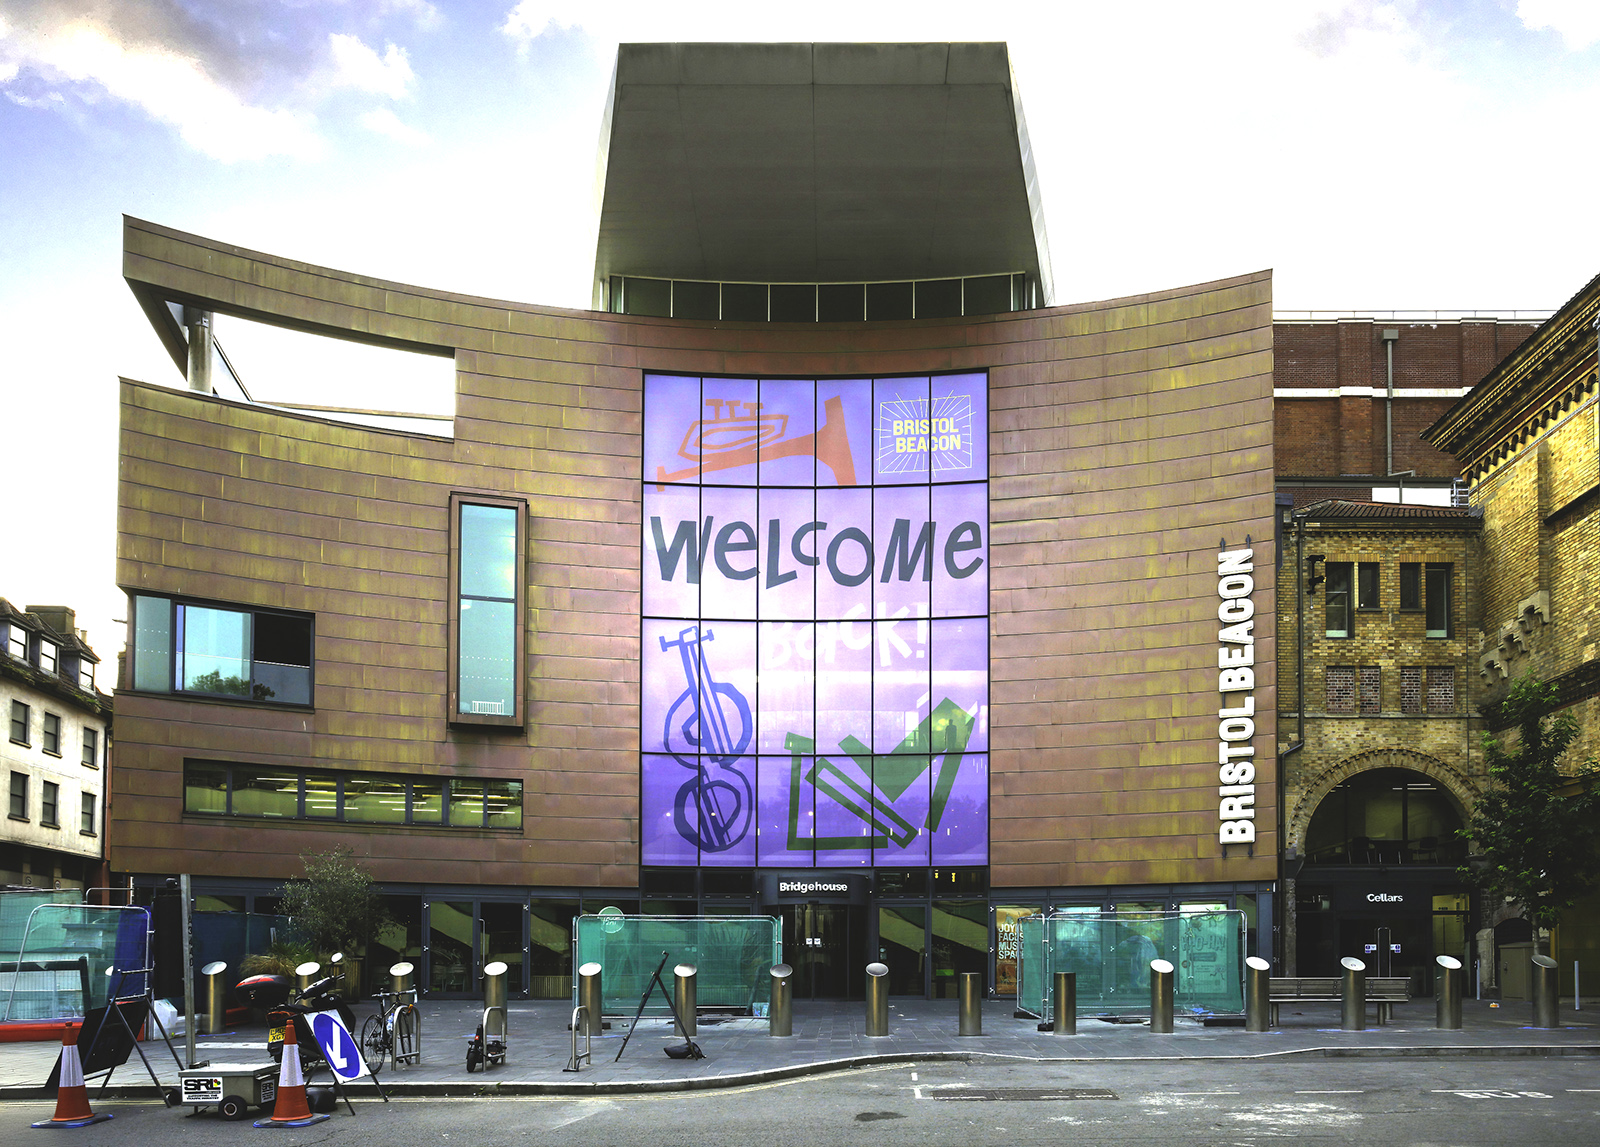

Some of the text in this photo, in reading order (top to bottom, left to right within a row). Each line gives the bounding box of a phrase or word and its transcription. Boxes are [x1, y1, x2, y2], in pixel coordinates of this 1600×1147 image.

[893, 416, 960, 436] BRISTOL
[895, 434, 962, 453] BEACON
[1217, 548, 1256, 845] BRISTOL BEACON
[778, 882, 848, 894] Bridgehouse
[1366, 893, 1404, 903] Cellars
[184, 1078, 221, 1091] SRL
